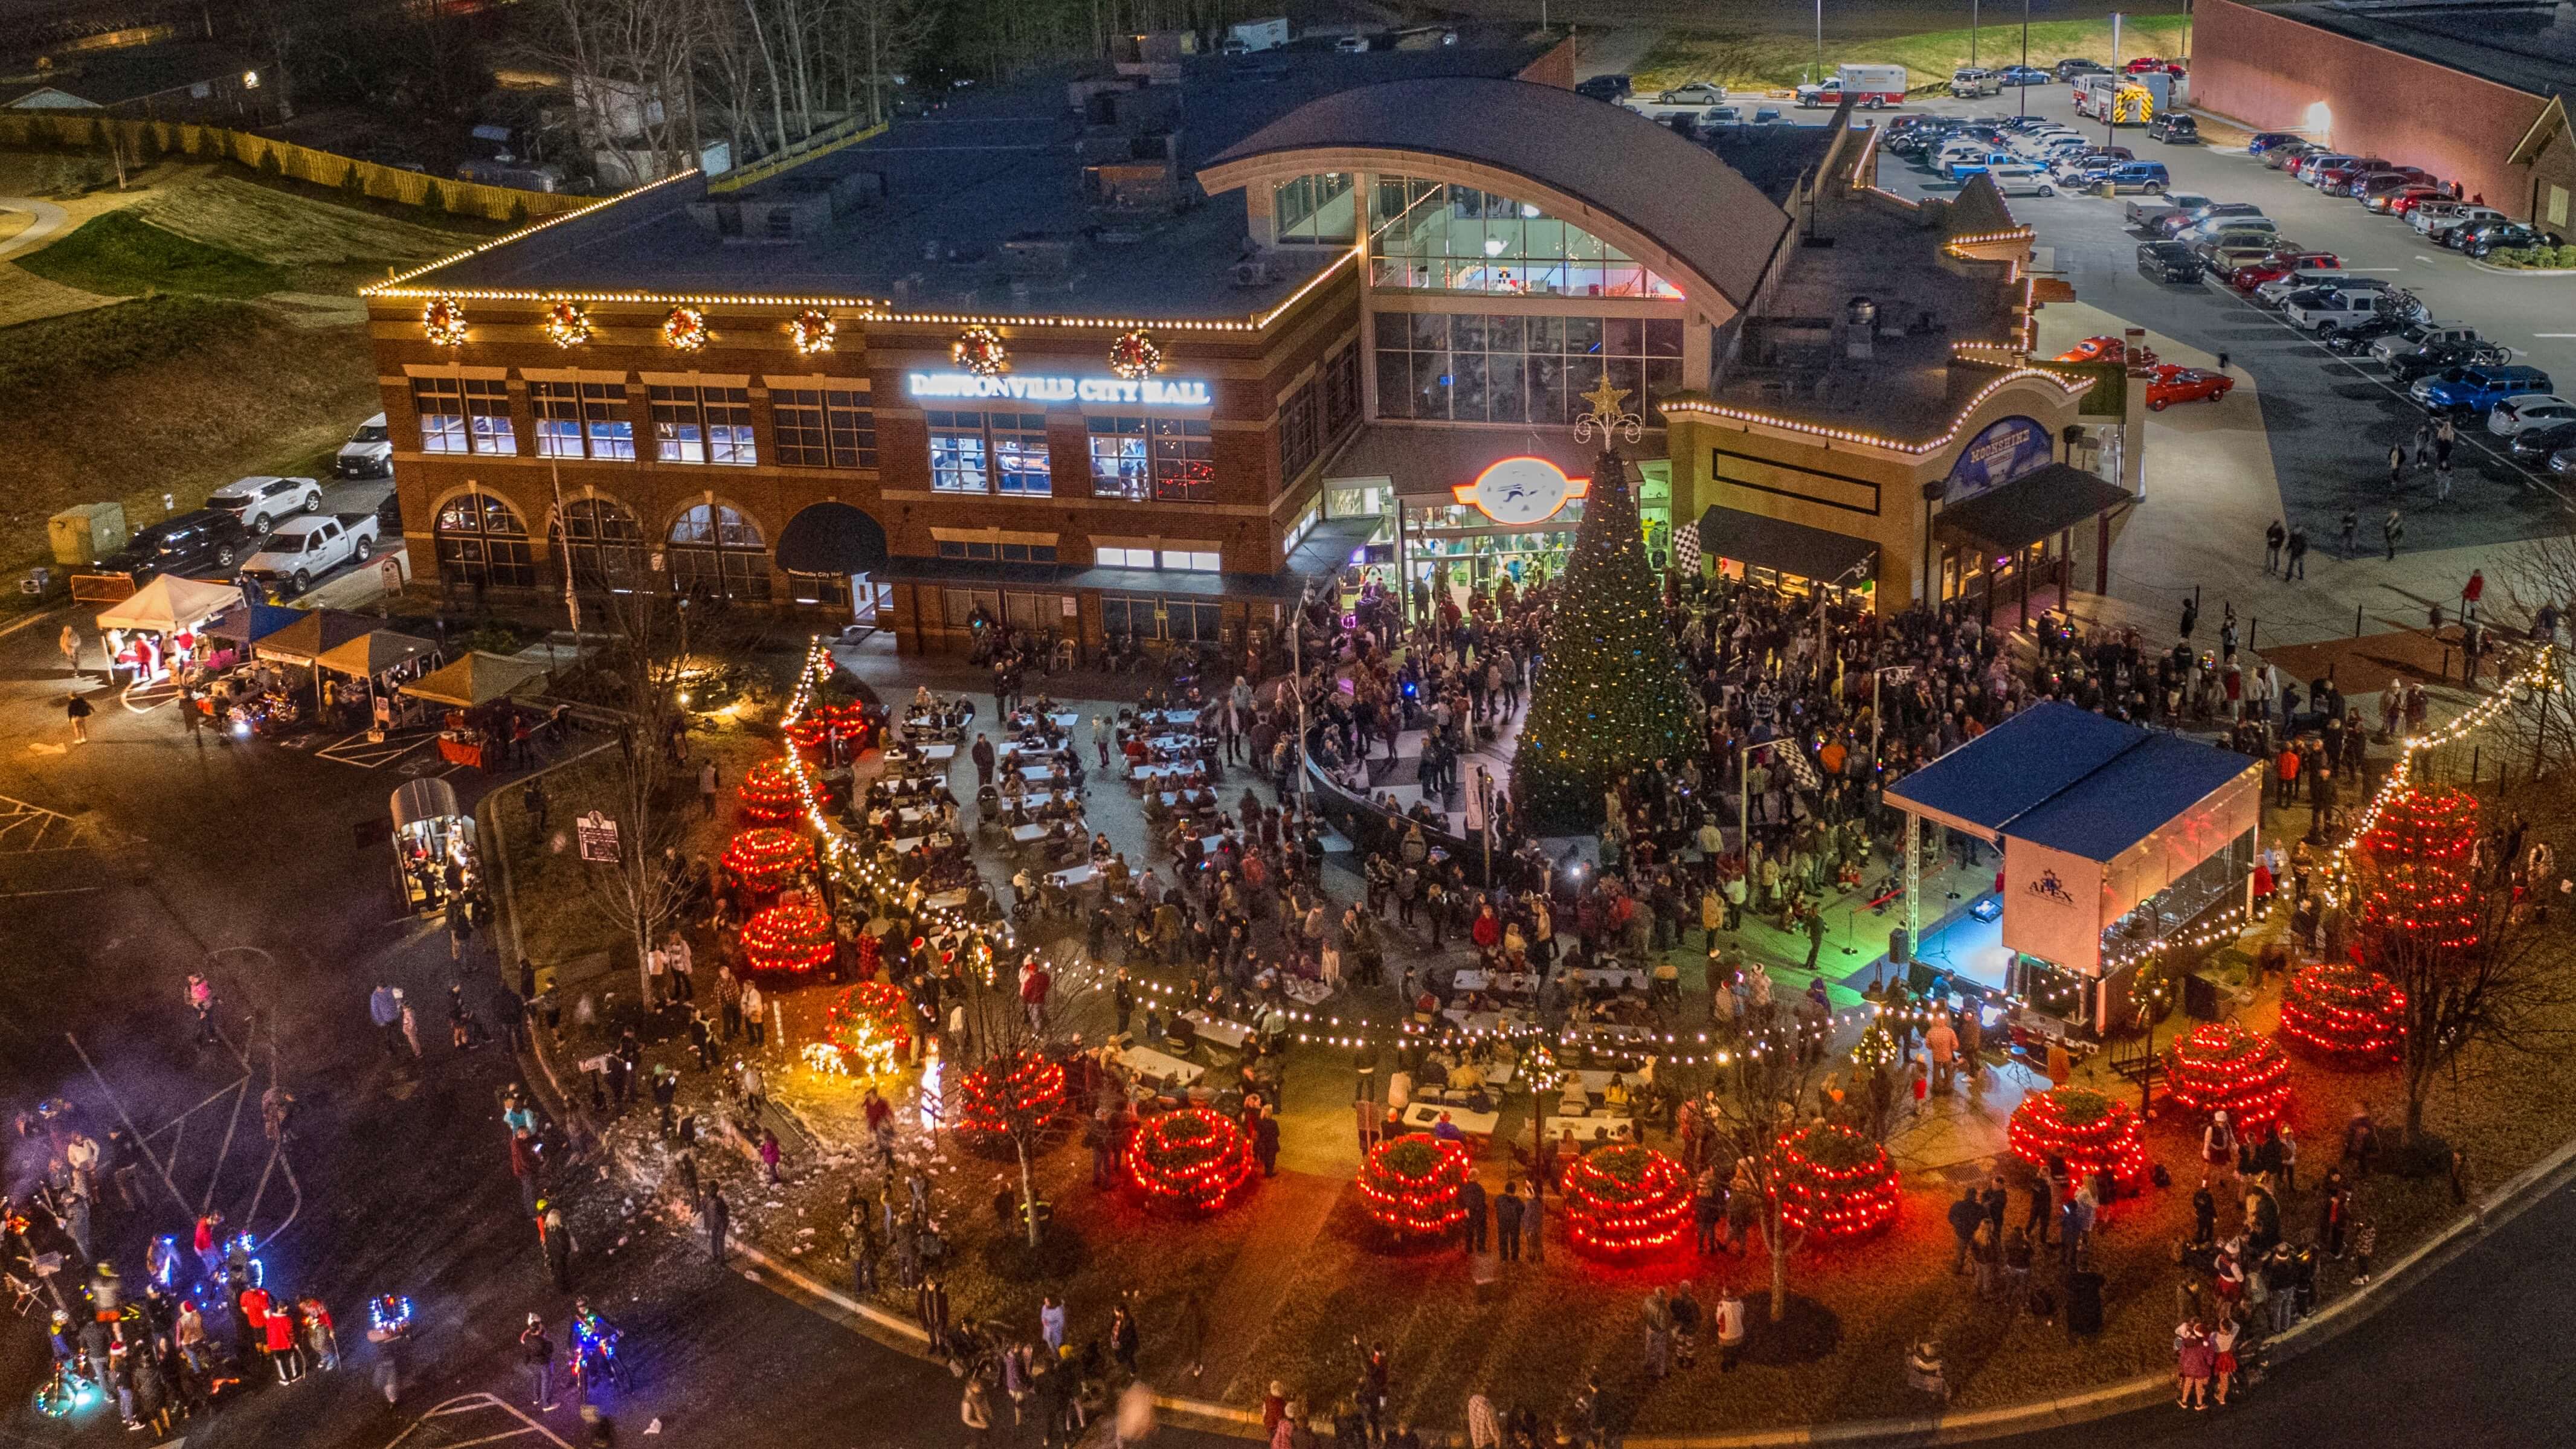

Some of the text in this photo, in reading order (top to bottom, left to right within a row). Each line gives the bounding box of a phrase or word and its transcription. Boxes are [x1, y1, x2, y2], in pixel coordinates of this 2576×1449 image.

[1078, 379, 1139, 401] CITY
[1141, 380, 1210, 405] HALL
[1971, 429, 2030, 463] MOONSHINE
[2029, 880, 2074, 903] APEX
